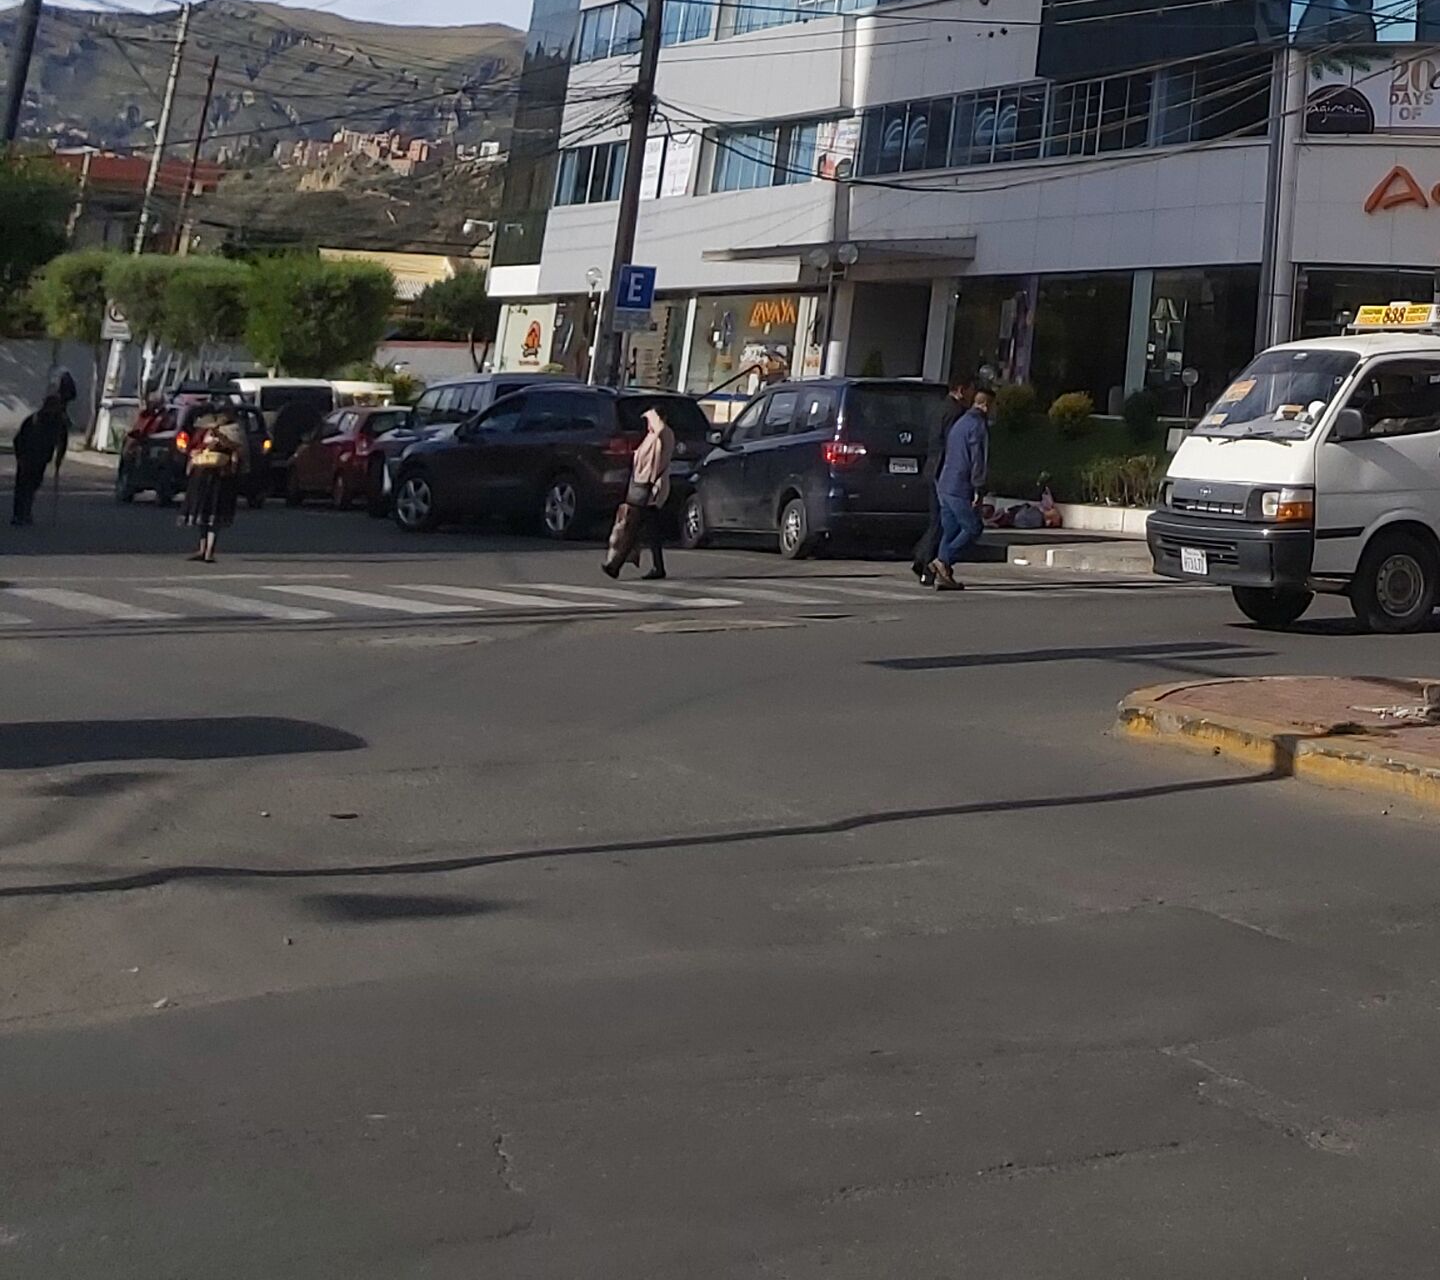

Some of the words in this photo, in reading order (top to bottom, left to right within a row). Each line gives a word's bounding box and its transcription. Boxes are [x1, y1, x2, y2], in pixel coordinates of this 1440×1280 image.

[1391, 59, 1437, 91] 20
[1389, 92, 1434, 107] DAYS
[1399, 107, 1422, 121] OF
[627, 272, 644, 302] E
